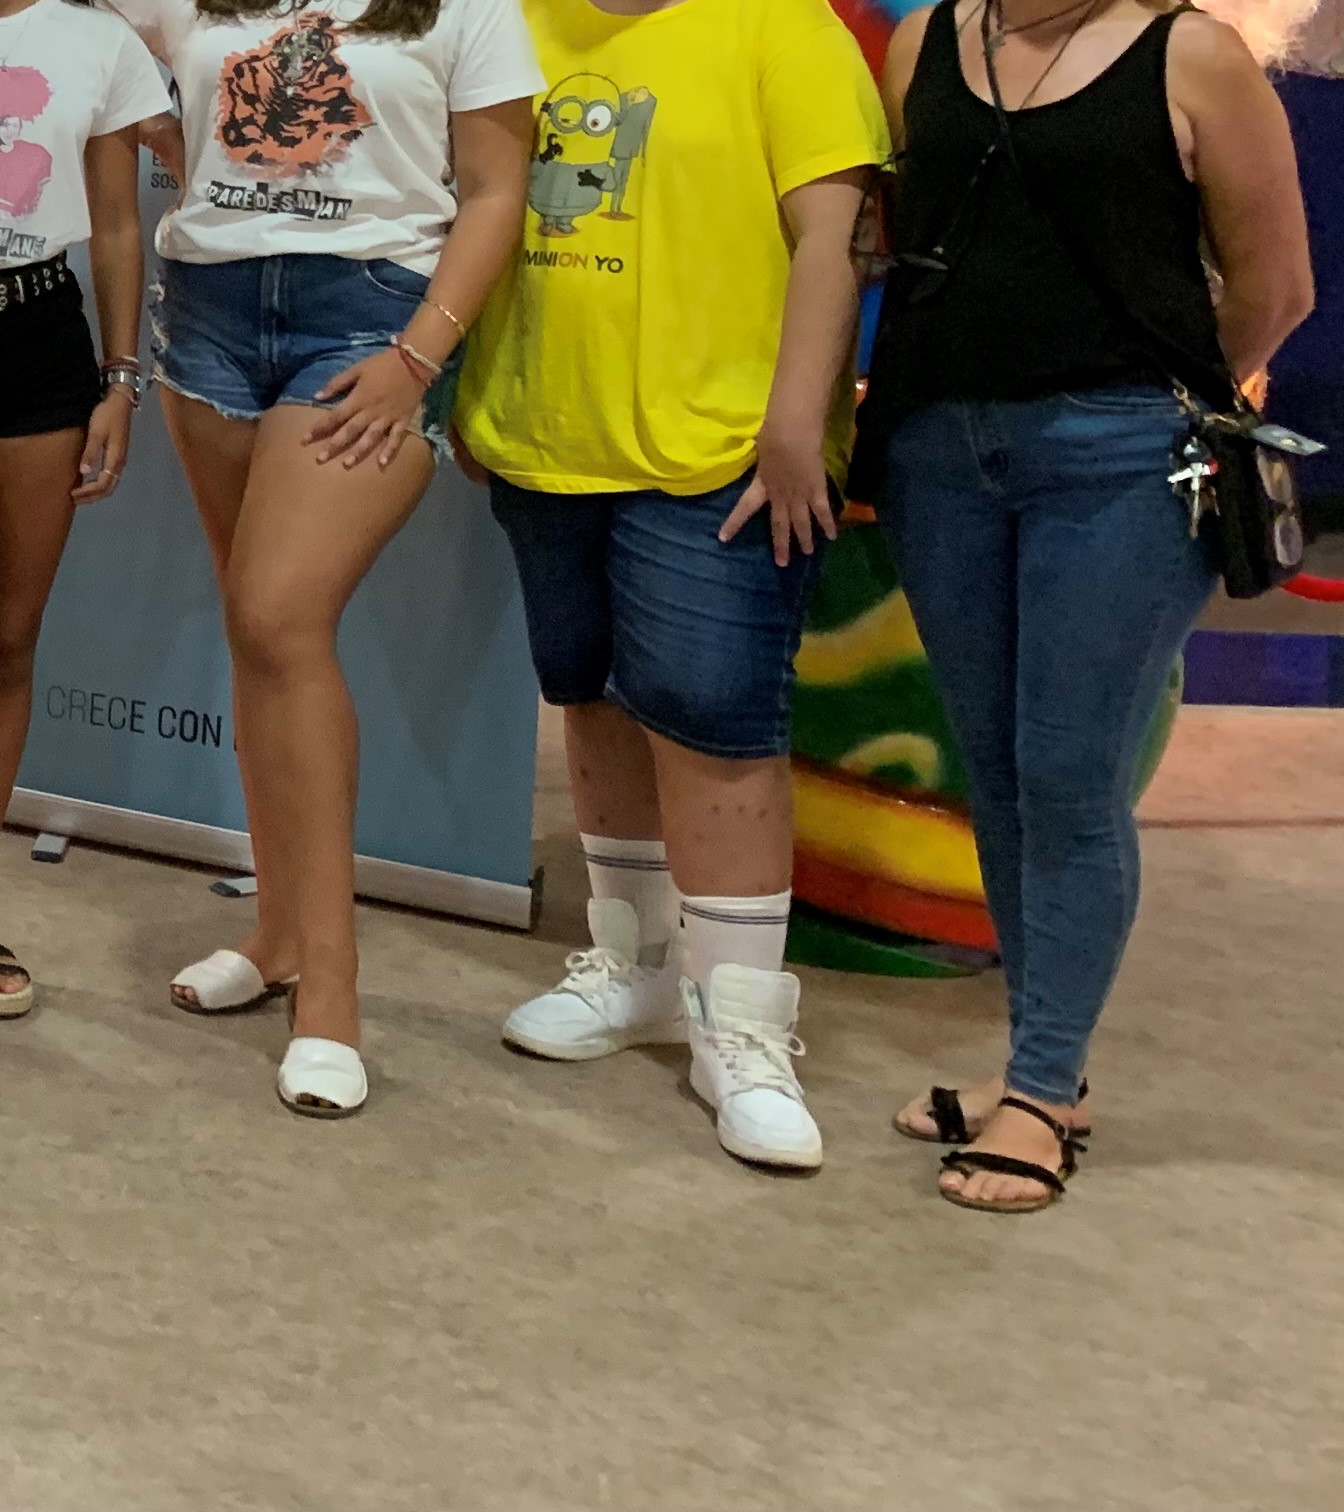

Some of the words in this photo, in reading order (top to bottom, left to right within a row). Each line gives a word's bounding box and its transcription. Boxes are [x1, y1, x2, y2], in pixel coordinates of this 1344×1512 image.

[594, 255, 624, 273] YO
[47, 685, 147, 735] CRECE
[158, 705, 223, 748] CON
